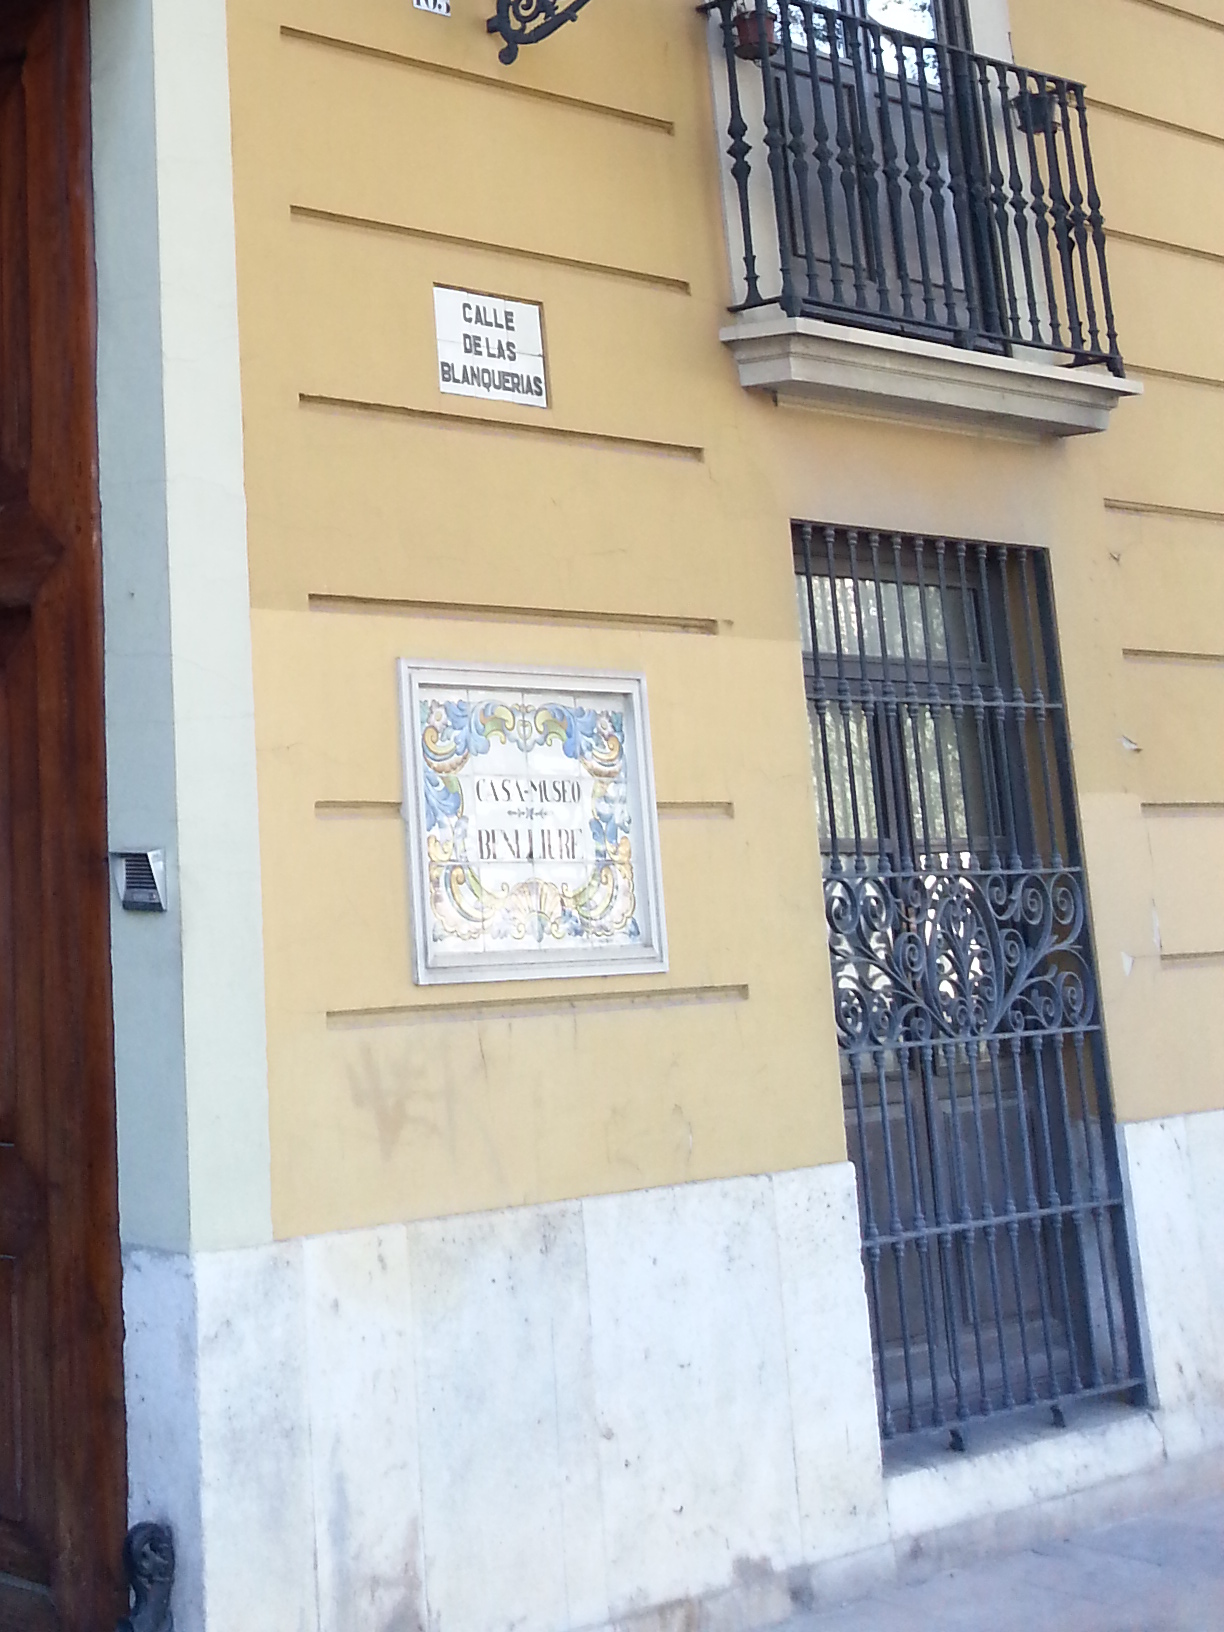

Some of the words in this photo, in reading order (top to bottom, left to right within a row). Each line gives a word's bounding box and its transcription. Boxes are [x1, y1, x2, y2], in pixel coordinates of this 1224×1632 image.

[462, 302, 515, 331] CALLE
[463, 333, 483, 356] DE
[485, 337, 517, 362] LAS
[440, 361, 543, 396] BLANQUERIAS
[476, 778, 581, 803] CASA-MUSEO
[478, 828, 583, 860] BENLLIURE
